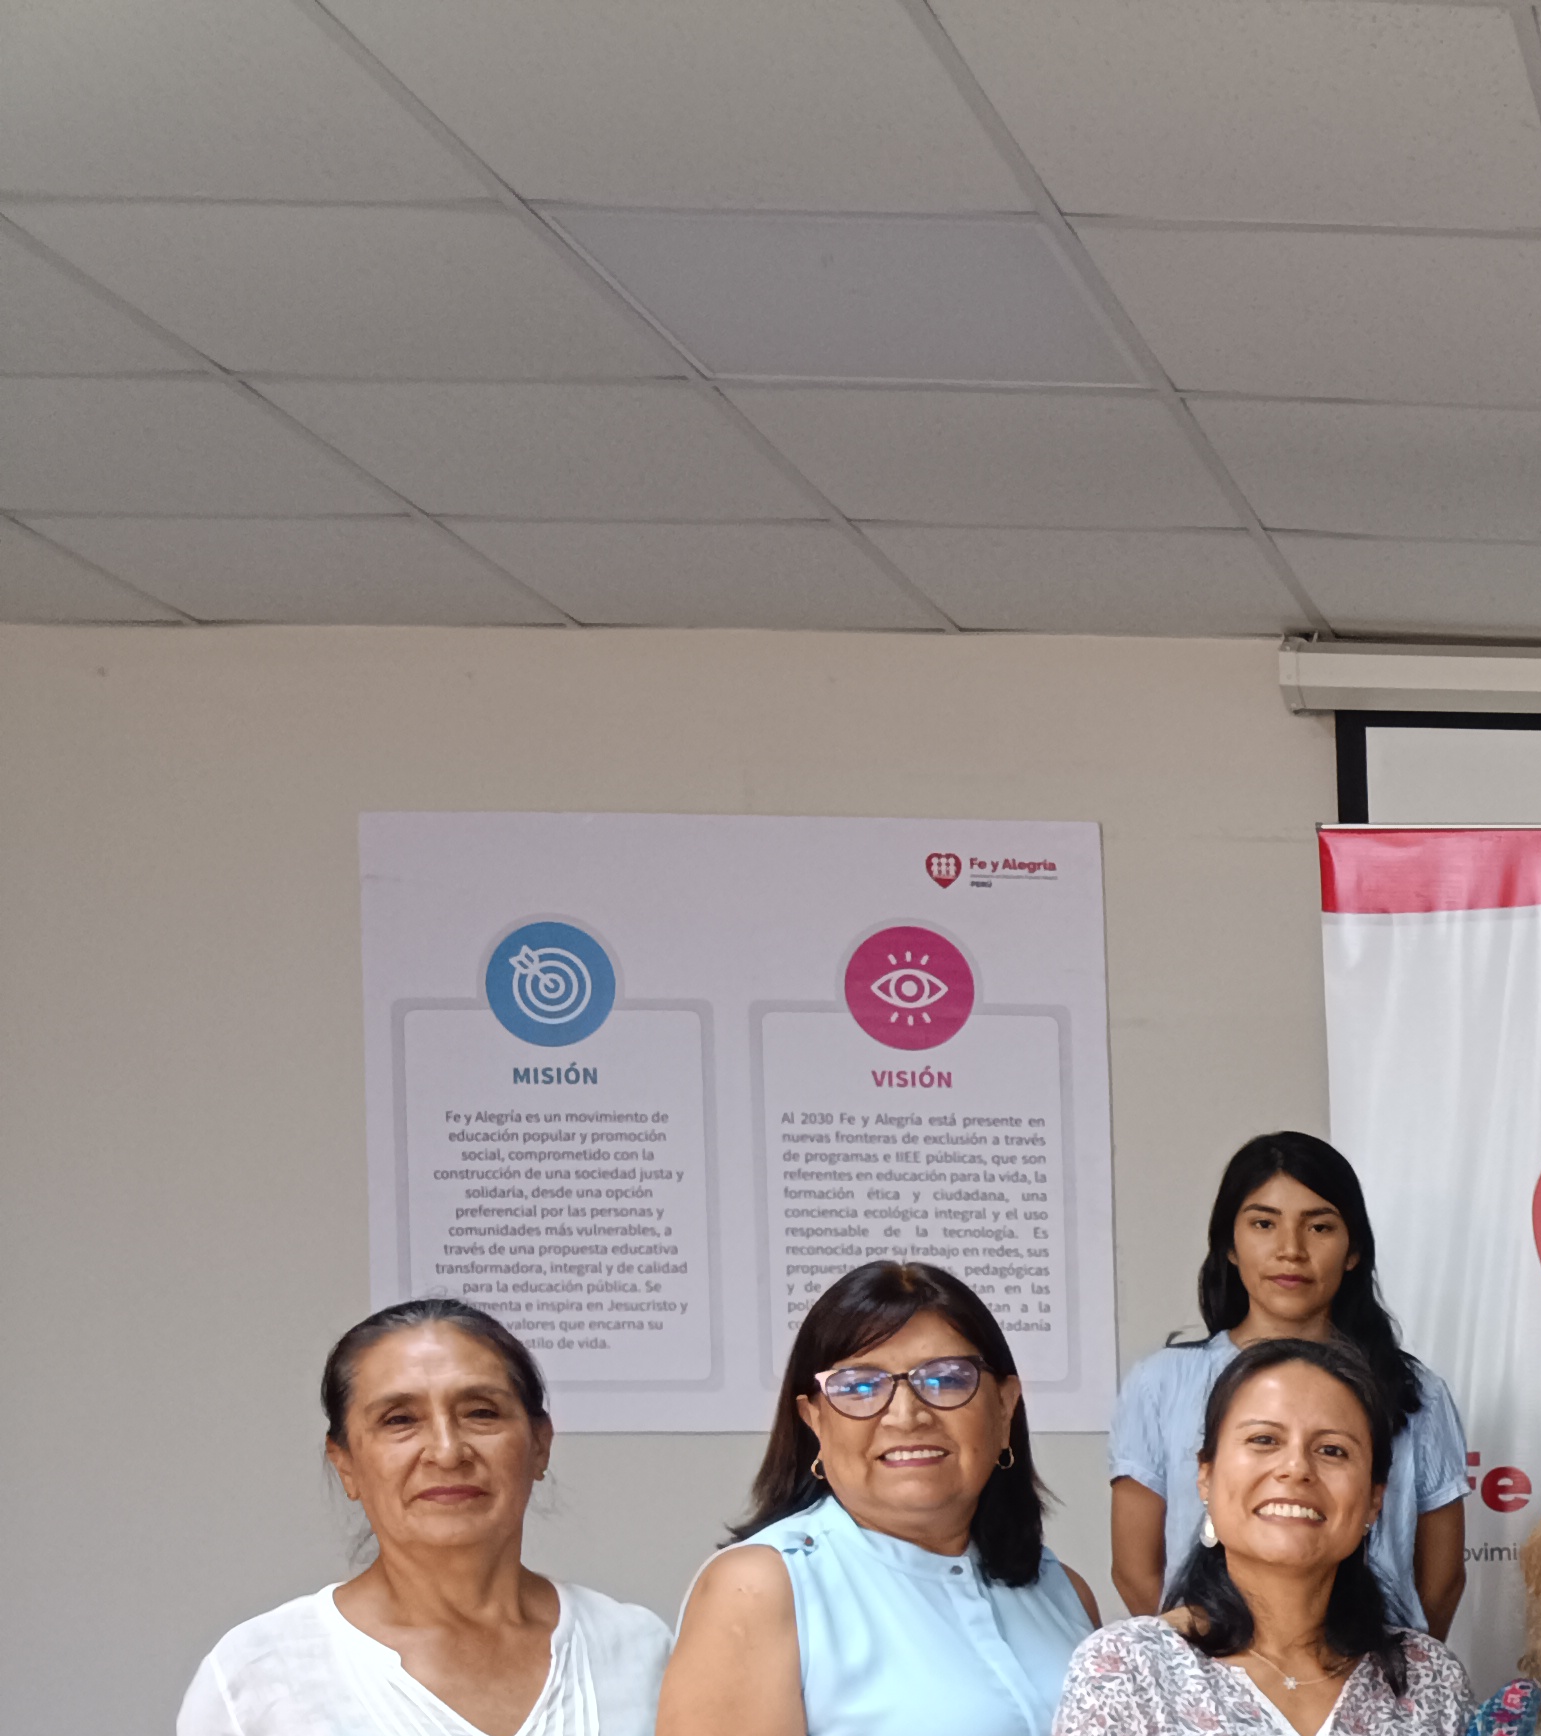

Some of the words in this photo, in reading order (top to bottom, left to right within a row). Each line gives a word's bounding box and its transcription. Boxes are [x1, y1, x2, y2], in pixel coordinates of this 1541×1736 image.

[969, 857, 987, 870] Fe
[991, 860, 1000, 873] y
[1002, 858, 1057, 873] Alegría
[513, 1062, 597, 1084] MISIÓN
[871, 1066, 952, 1088] VISIÓN
[446, 1111, 461, 1122] Fe
[475, 1109, 521, 1126] Alegría
[525, 1113, 540, 1123] es
[544, 1113, 561, 1123] un
[565, 1111, 648, 1123] movimiento
[651, 1111, 669, 1123] de
[781, 1112, 794, 1124] Al
[801, 1112, 833, 1125] 2030
[840, 1112, 855, 1125] Fe
[875, 1113, 922, 1128] Alegría
[928, 1113, 956, 1126] está
[963, 1117, 1022, 1128] presente
[1028, 1118, 1045, 1127] en
[448, 1129, 519, 1142] educación
[523, 1129, 576, 1144] popular
[591, 1129, 666, 1144] promoción
[782, 1134, 831, 1143] nuevas
[835, 1131, 897, 1144] fronteras
[902, 1132, 919, 1144] de
[923, 1132, 987, 1145] exclusión
[1004, 1133, 1046, 1146] través
[462, 1148, 505, 1162] social,
[508, 1149, 610, 1163] comprometido
[614, 1151, 638, 1161] con
[642, 1148, 654, 1161] la
[783, 1150, 800, 1162] de
[805, 1152, 879, 1165] programas
[926, 1151, 987, 1165] públicas,
[991, 1155, 1017, 1166] que
[1022, 1155, 1046, 1164] son
[433, 1166, 521, 1180] construcción
[525, 1167, 541, 1179] de
[545, 1170, 571, 1179] una
[575, 1167, 636, 1179] sociedad
[640, 1168, 672, 1182] justa
[783, 1168, 853, 1181] referentes
[856, 1172, 873, 1181] en
[876, 1170, 946, 1182] educación
[950, 1173, 980, 1184] para
[983, 1170, 995, 1182] la
[999, 1171, 1032, 1185] vida,
[1034, 1171, 1047, 1183] la
[531, 1186, 572, 1198] desde
[576, 1189, 602, 1198] una
[606, 1185, 653, 1201] opción
[784, 1186, 854, 1200] formación
[867, 1188, 900, 1200] ética
[933, 1189, 1009, 1203] ciudadana,
[1022, 1193, 1047, 1202] una
[456, 1205, 537, 1220] preferencial
[541, 1208, 563, 1219] por
[568, 1205, 586, 1217] las
[590, 1208, 653, 1220] personas
[784, 1207, 858, 1218] conciencia
[864, 1206, 928, 1222] ecológica
[935, 1208, 986, 1223] integral
[1005, 1208, 1018, 1220] el
[1024, 1211, 1048, 1220] uso
[448, 1224, 541, 1237] comunidades
[545, 1223, 573, 1236] más
[576, 1224, 660, 1237] vulnerables,
[785, 1225, 869, 1239] responsable
[884, 1225, 901, 1237] de
[916, 1225, 928, 1237] la
[943, 1225, 1018, 1241] tecnología.
[1033, 1227, 1049, 1239] Es
[444, 1242, 485, 1255] través
[488, 1243, 505, 1255] de
[509, 1245, 534, 1255] una
[539, 1245, 608, 1257] propuesta
[611, 1243, 678, 1255] educativa
[786, 1244, 862, 1256] reconocida
[865, 1247, 889, 1257] por
[892, 1246, 907, 1256] su
[911, 1244, 959, 1259] trabajo
[962, 1247, 979, 1257] en
[982, 1245, 1024, 1258] redes,
[1027, 1248, 1049, 1257] sus
[435, 1261, 546, 1275] transformadora,
[550, 1262, 602, 1277] integral
[617, 1262, 634, 1274] de
[637, 1261, 687, 1274] calidad
[964, 1263, 1050, 1279] pedagógicas
[463, 1283, 492, 1295] para
[496, 1280, 508, 1293] la
[512, 1280, 583, 1293] educación
[587, 1280, 640, 1294] pública.
[645, 1280, 661, 1293] Se
[805, 1281, 821, 1292] de
[1004, 1285, 1021, 1294] en
[1031, 1282, 1050, 1295] las
[537, 1300, 583, 1314] inspira
[587, 1302, 603, 1311] en
[607, 1300, 677, 1312] Jesucristo
[1038, 1301, 1051, 1313] la
[559, 1321, 585, 1332] que
[589, 1321, 644, 1330] encarna
[648, 1321, 663, 1330] su
[557, 1337, 574, 1349] de
[578, 1337, 610, 1349] vida.
